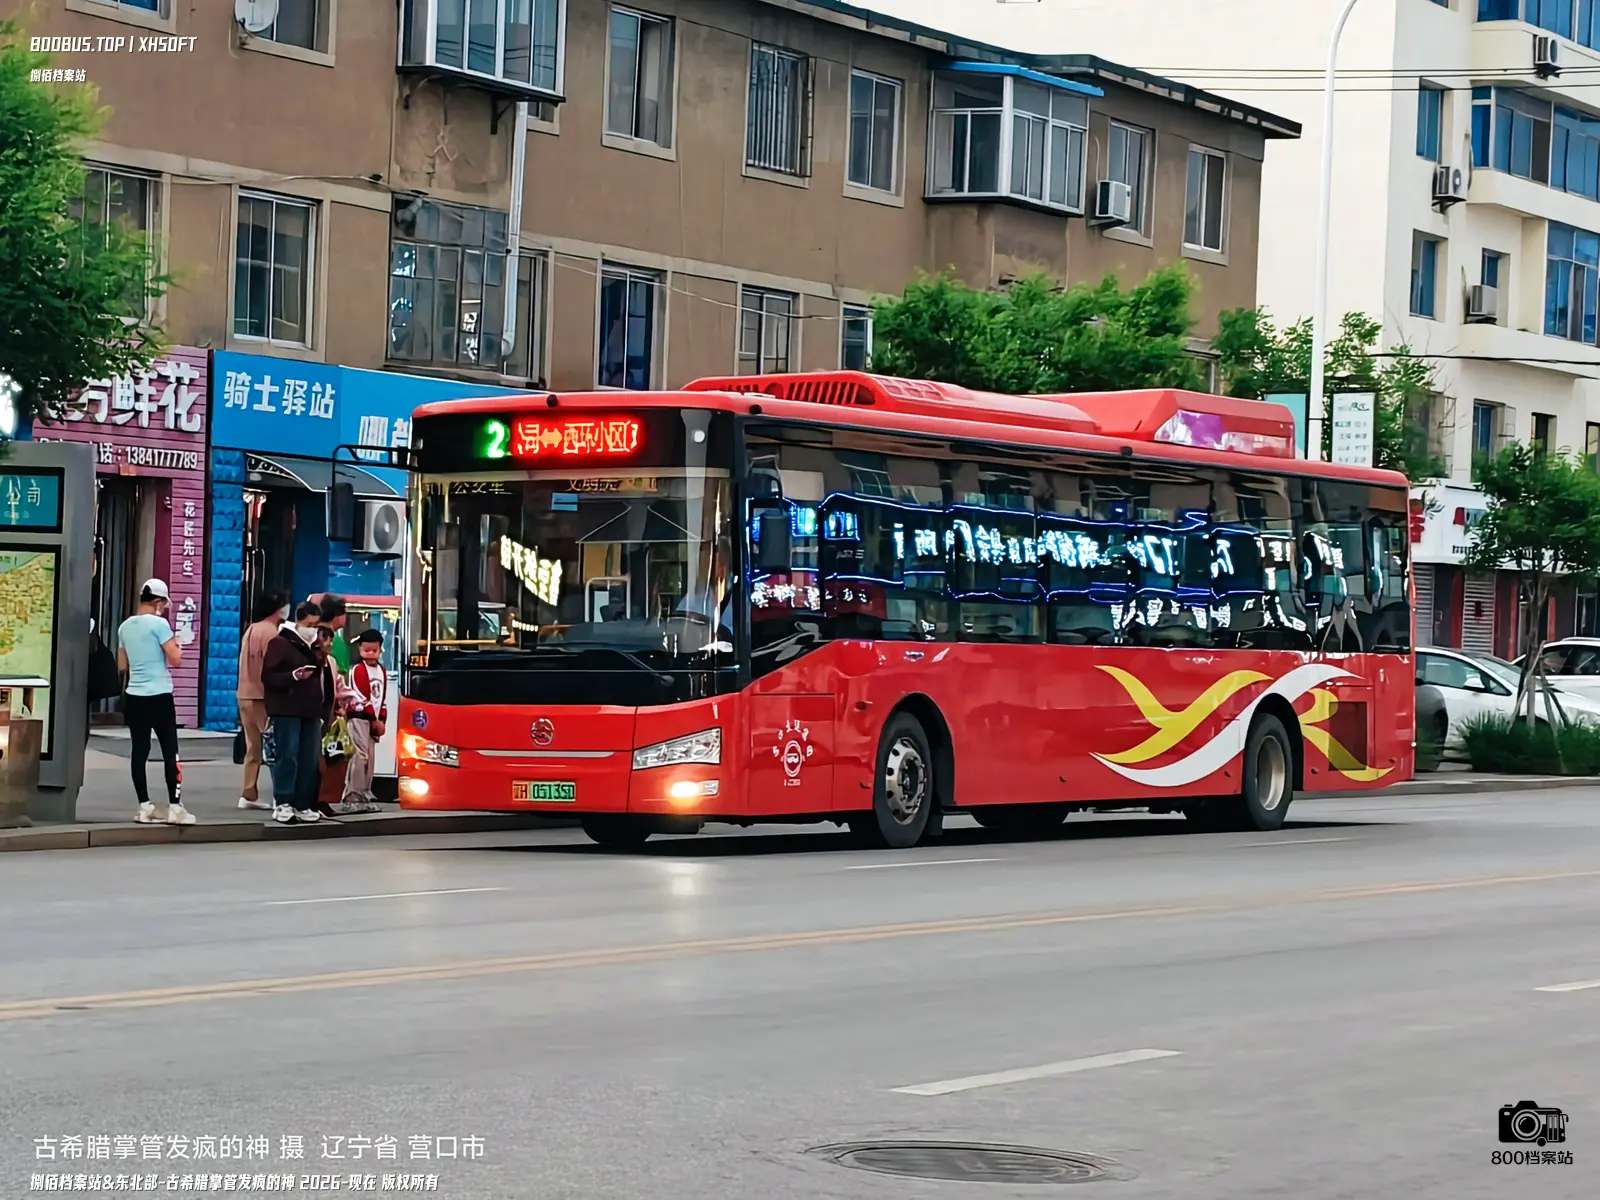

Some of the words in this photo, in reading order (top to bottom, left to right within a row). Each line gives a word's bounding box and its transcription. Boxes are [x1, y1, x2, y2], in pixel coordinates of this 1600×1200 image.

[224, 371, 336, 419] 骑士驿站
[488, 421, 505, 458] 2
